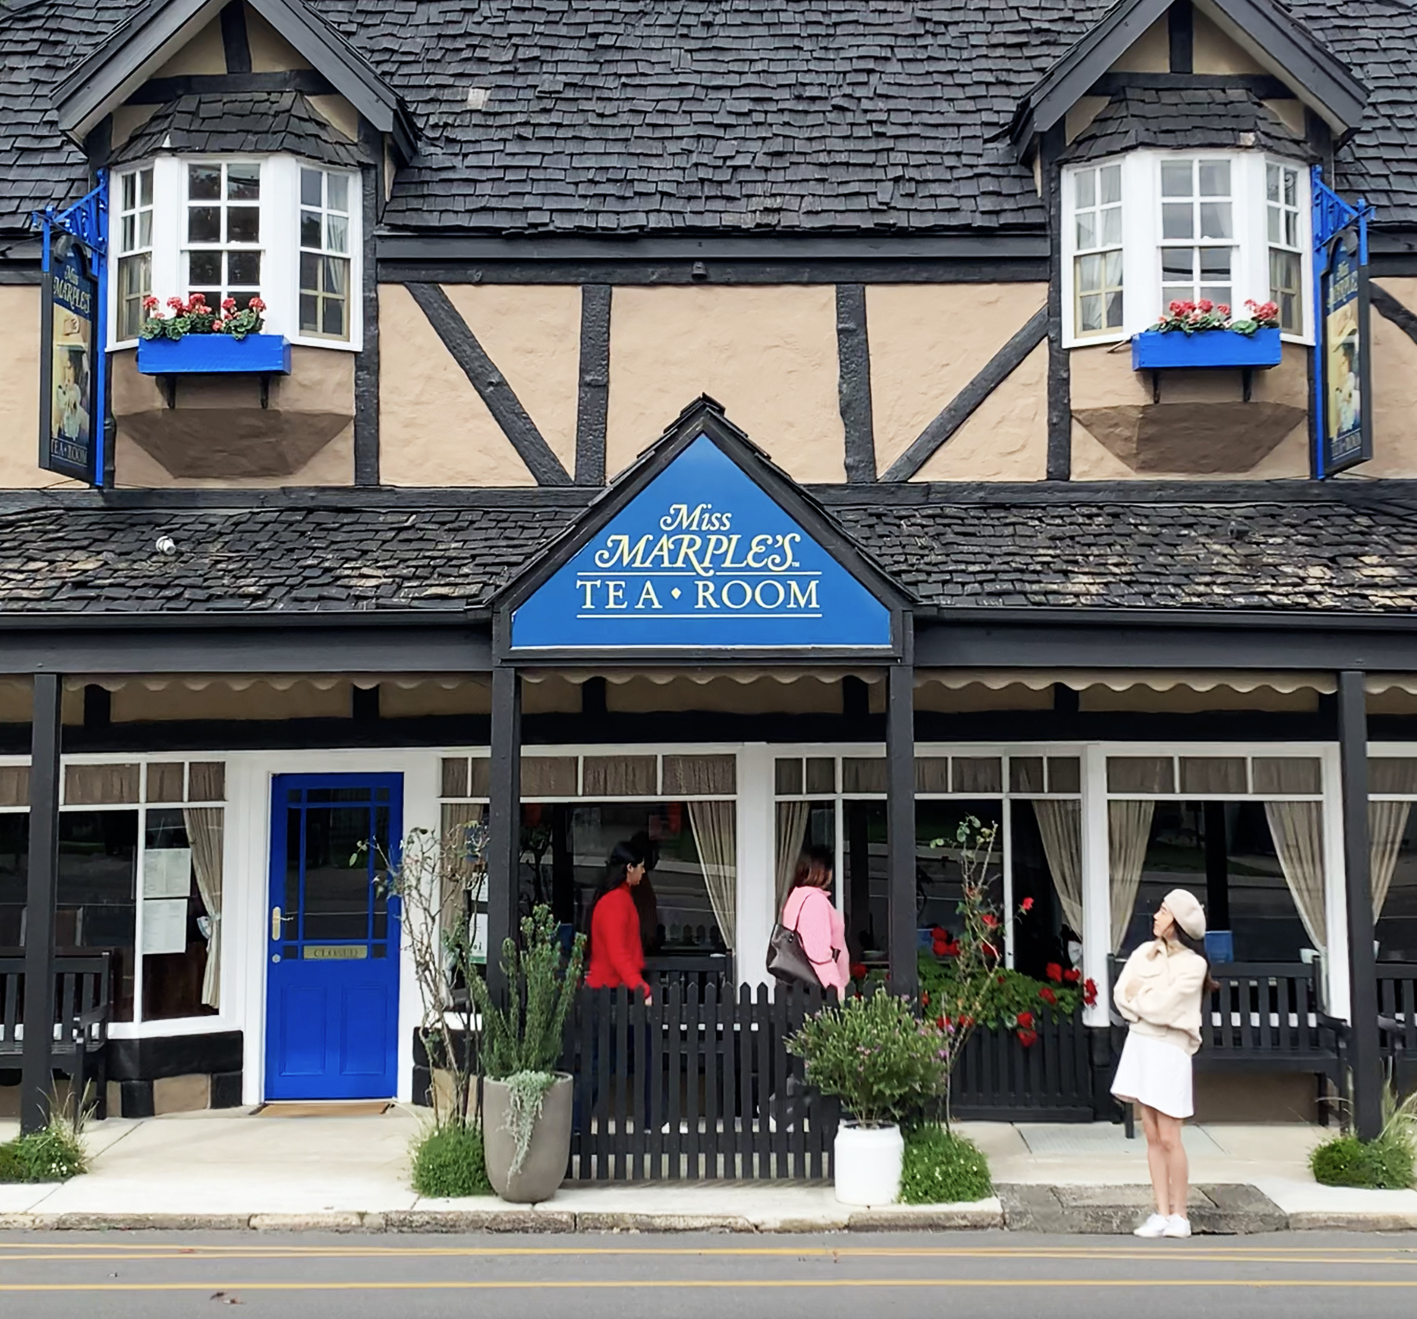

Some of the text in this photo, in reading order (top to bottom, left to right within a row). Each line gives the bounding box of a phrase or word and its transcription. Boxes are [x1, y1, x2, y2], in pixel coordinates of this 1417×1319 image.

[660, 504, 732, 531] Miss
[595, 533, 801, 577] MARPLE'S
[577, 579, 820, 609] TEA ROOM
